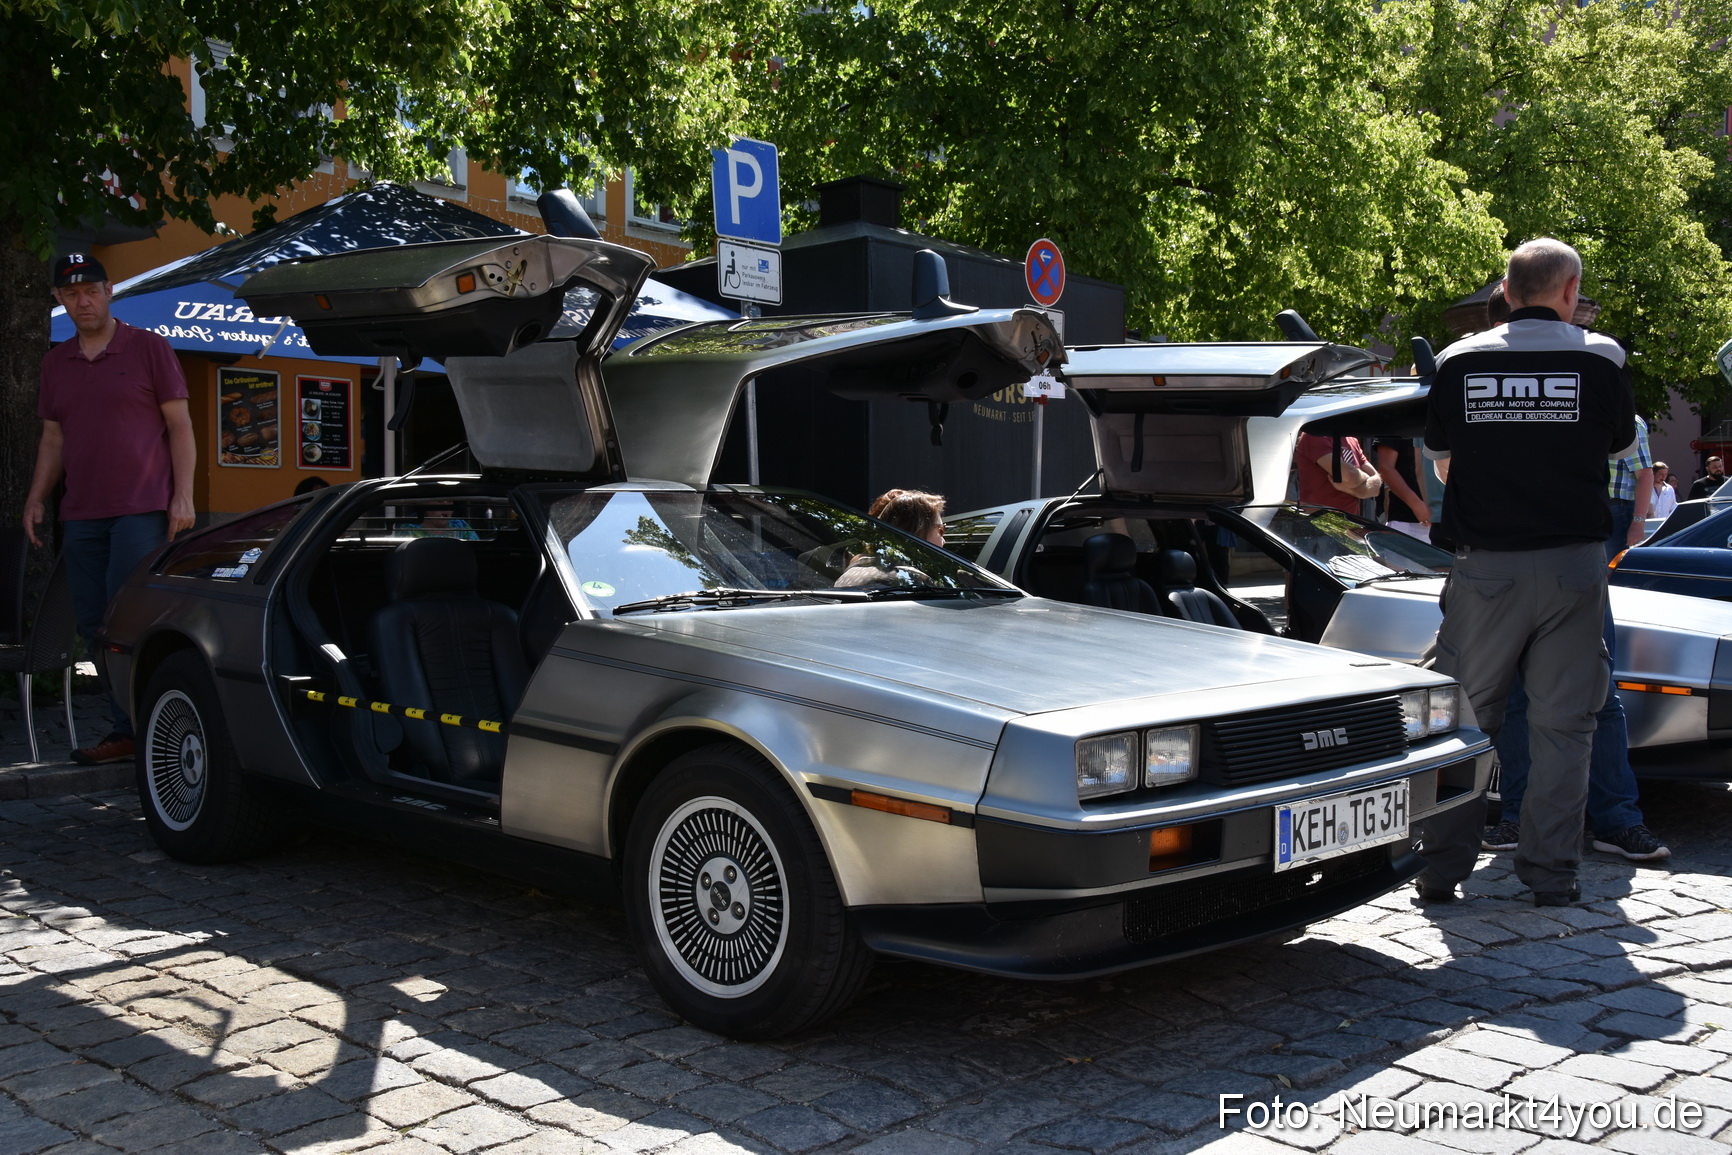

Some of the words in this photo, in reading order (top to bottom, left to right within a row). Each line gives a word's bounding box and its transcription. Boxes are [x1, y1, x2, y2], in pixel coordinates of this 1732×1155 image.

[728, 149, 764, 225] P
[69, 254, 84, 264] 13
[1038, 381, 1051, 390] 06h
[1478, 400, 1504, 408] LOREAN
[1508, 400, 1535, 408] MOTOR
[1540, 400, 1575, 408] COMPANY
[973, 403, 1006, 421] NEUMARKT
[1012, 411, 1025, 423] SEIT
[1027, 410, 1035, 422] 18
[1505, 412, 1523, 420] CLUB
[1525, 412, 1573, 420] DEUTSCHLAND
[1292, 804, 1337, 854] KEH
[1281, 842, 1286, 855] D
